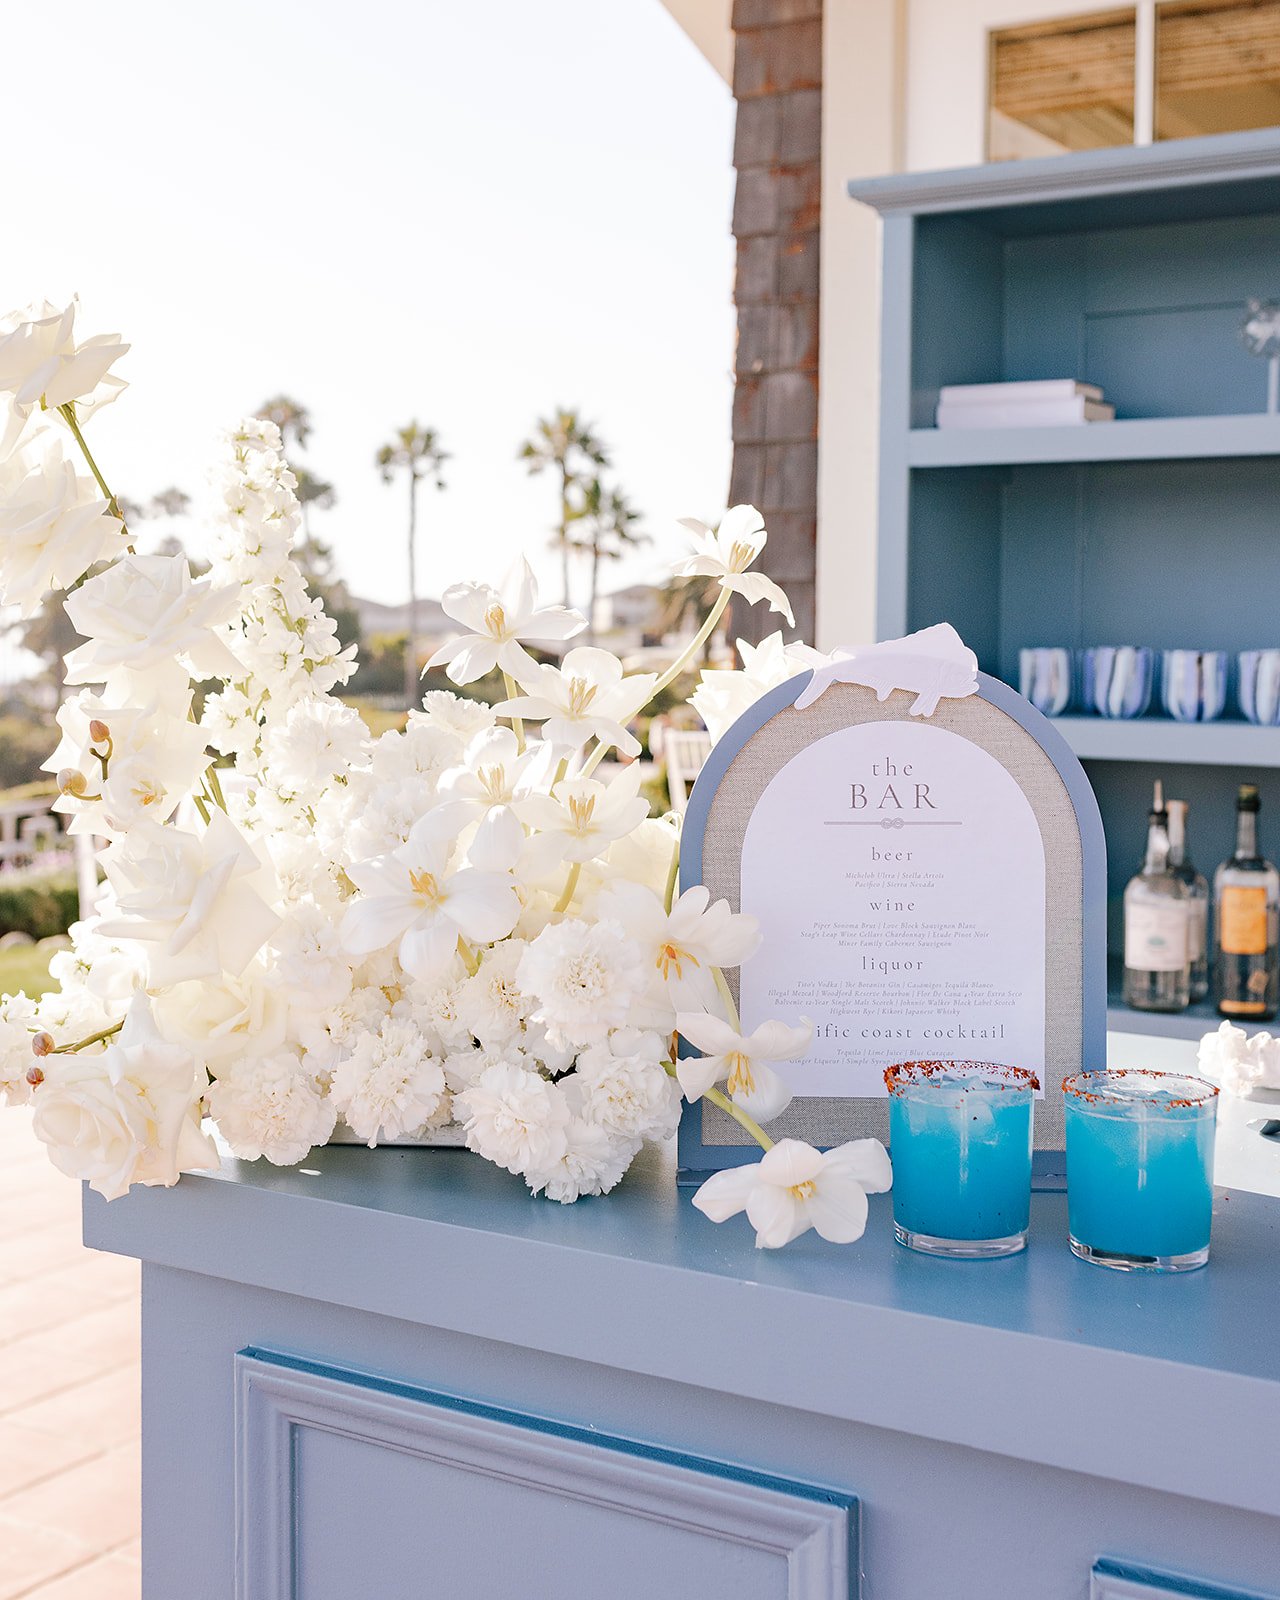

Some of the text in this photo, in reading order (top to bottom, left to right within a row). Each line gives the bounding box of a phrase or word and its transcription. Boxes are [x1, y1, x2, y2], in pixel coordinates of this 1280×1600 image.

[872, 757, 914, 777] the
[849, 783, 939, 810] BAR
[871, 846, 914, 862] beer
[855, 881, 881, 890] Pacifico
[869, 899, 916, 912] wine
[813, 922, 831, 931] Piper
[921, 922, 956, 931] Sauvignon
[800, 931, 820, 939] Stag's
[822, 931, 838, 939] Leap
[885, 931, 925, 940] Chardonnay
[860, 940, 882, 949] Family
[918, 940, 953, 949] Sauvignon
[862, 956, 925, 975] liquor
[907, 981, 942, 990] Casamigos
[945, 981, 969, 990] Tequila
[768, 990, 790, 998] Illegal
[821, 990, 852, 999] Woodford
[831, 999, 852, 1008] Single
[900, 999, 926, 1007] Johnnie
[830, 1007, 860, 1016] Highwest
[862, 1008, 876, 1016] Rye
[905, 1008, 935, 1017] Japanese
[937, 1008, 961, 1017] Whisky
[816, 1023, 1006, 1039] ific coast cocktail
[837, 1049, 862, 1058] Tequila
[886, 1049, 903, 1057] Juice
[814, 1058, 840, 1066] Liqueur
[846, 1058, 869, 1067] Simple
[871, 1058, 891, 1067] Syrup
